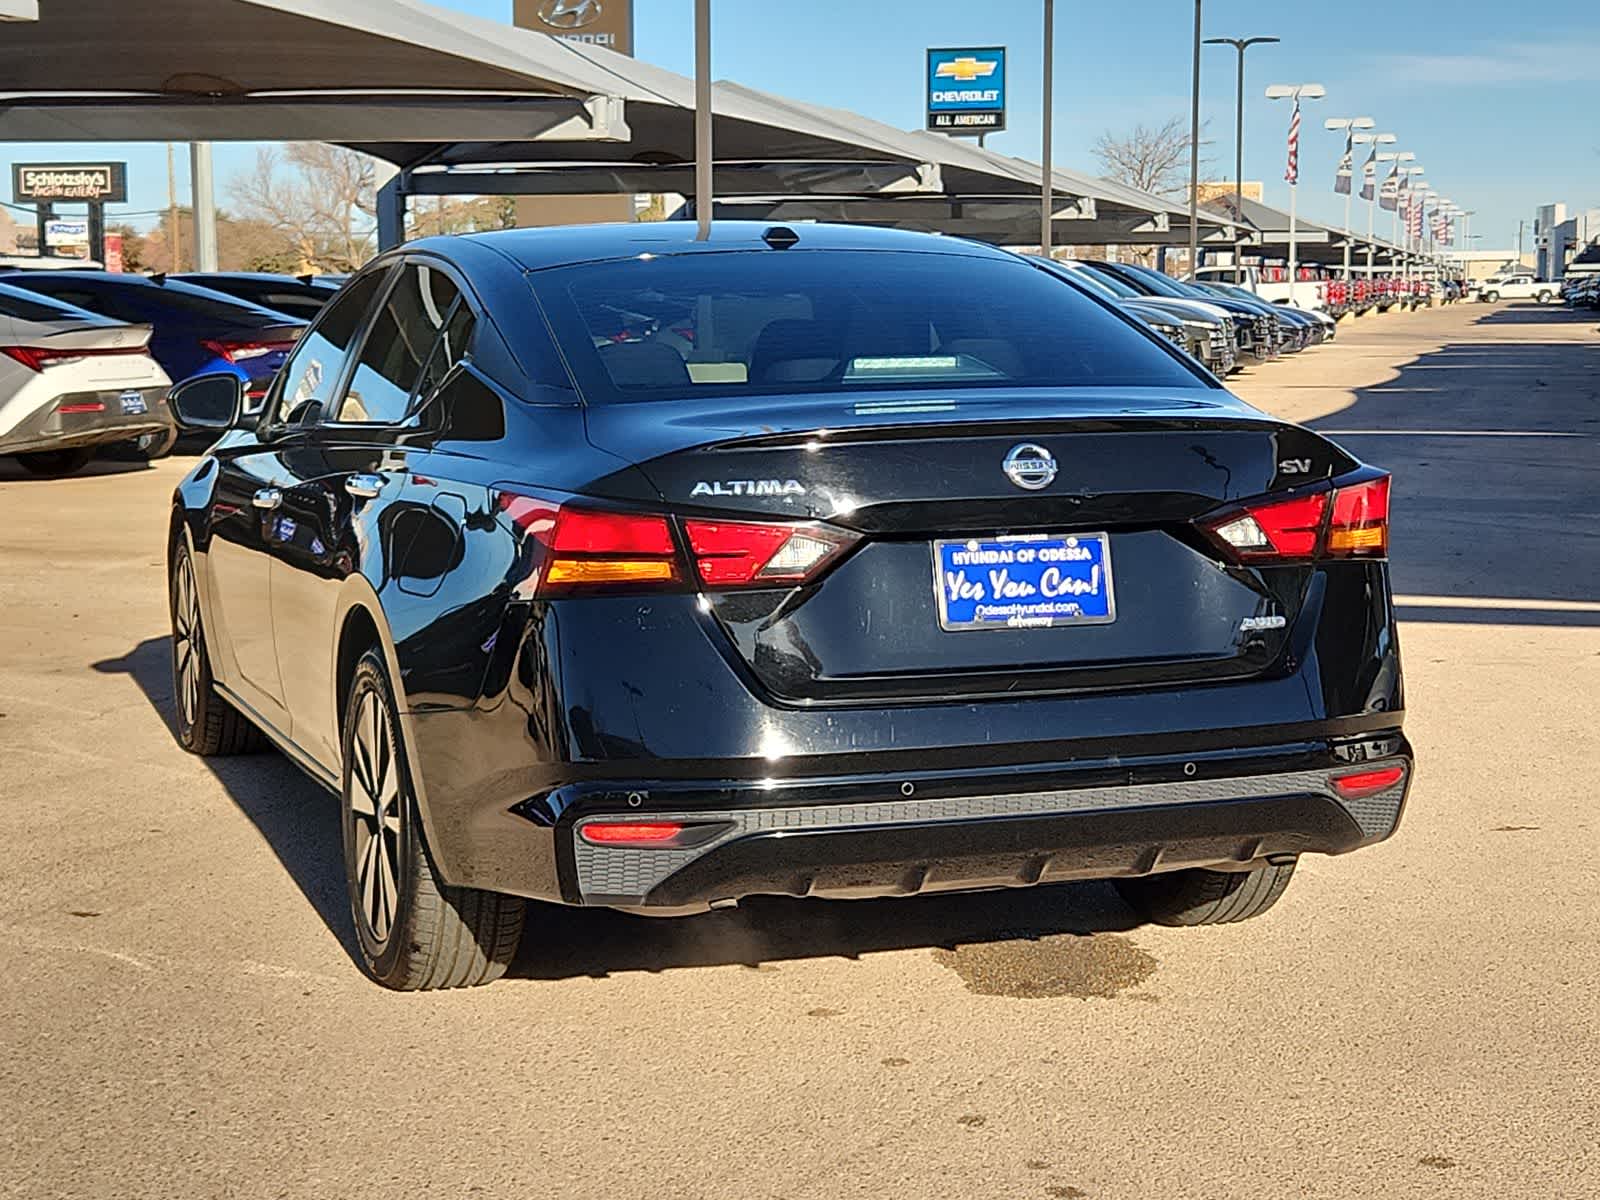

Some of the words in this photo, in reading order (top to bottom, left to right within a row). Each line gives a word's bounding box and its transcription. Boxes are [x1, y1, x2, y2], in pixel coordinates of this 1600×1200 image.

[932, 90, 1000, 102] CHEVROLET
[936, 115, 952, 125] ALL
[954, 114, 996, 125] AMERICAN
[26, 171, 104, 187] Schlotzsky's
[64, 186, 100, 198] EATERY
[1010, 460, 1053, 470] NISSAN
[1279, 458, 1312, 473] SV
[689, 479, 807, 497] ALTIMA
[952, 551, 1014, 565] HYUNDAI
[1017, 549, 1036, 563] OF
[1038, 547, 1092, 562] ODESSA
[947, 570, 986, 600] Yes
[989, 568, 1036, 599] You
[1040, 564, 1100, 597] Can!
